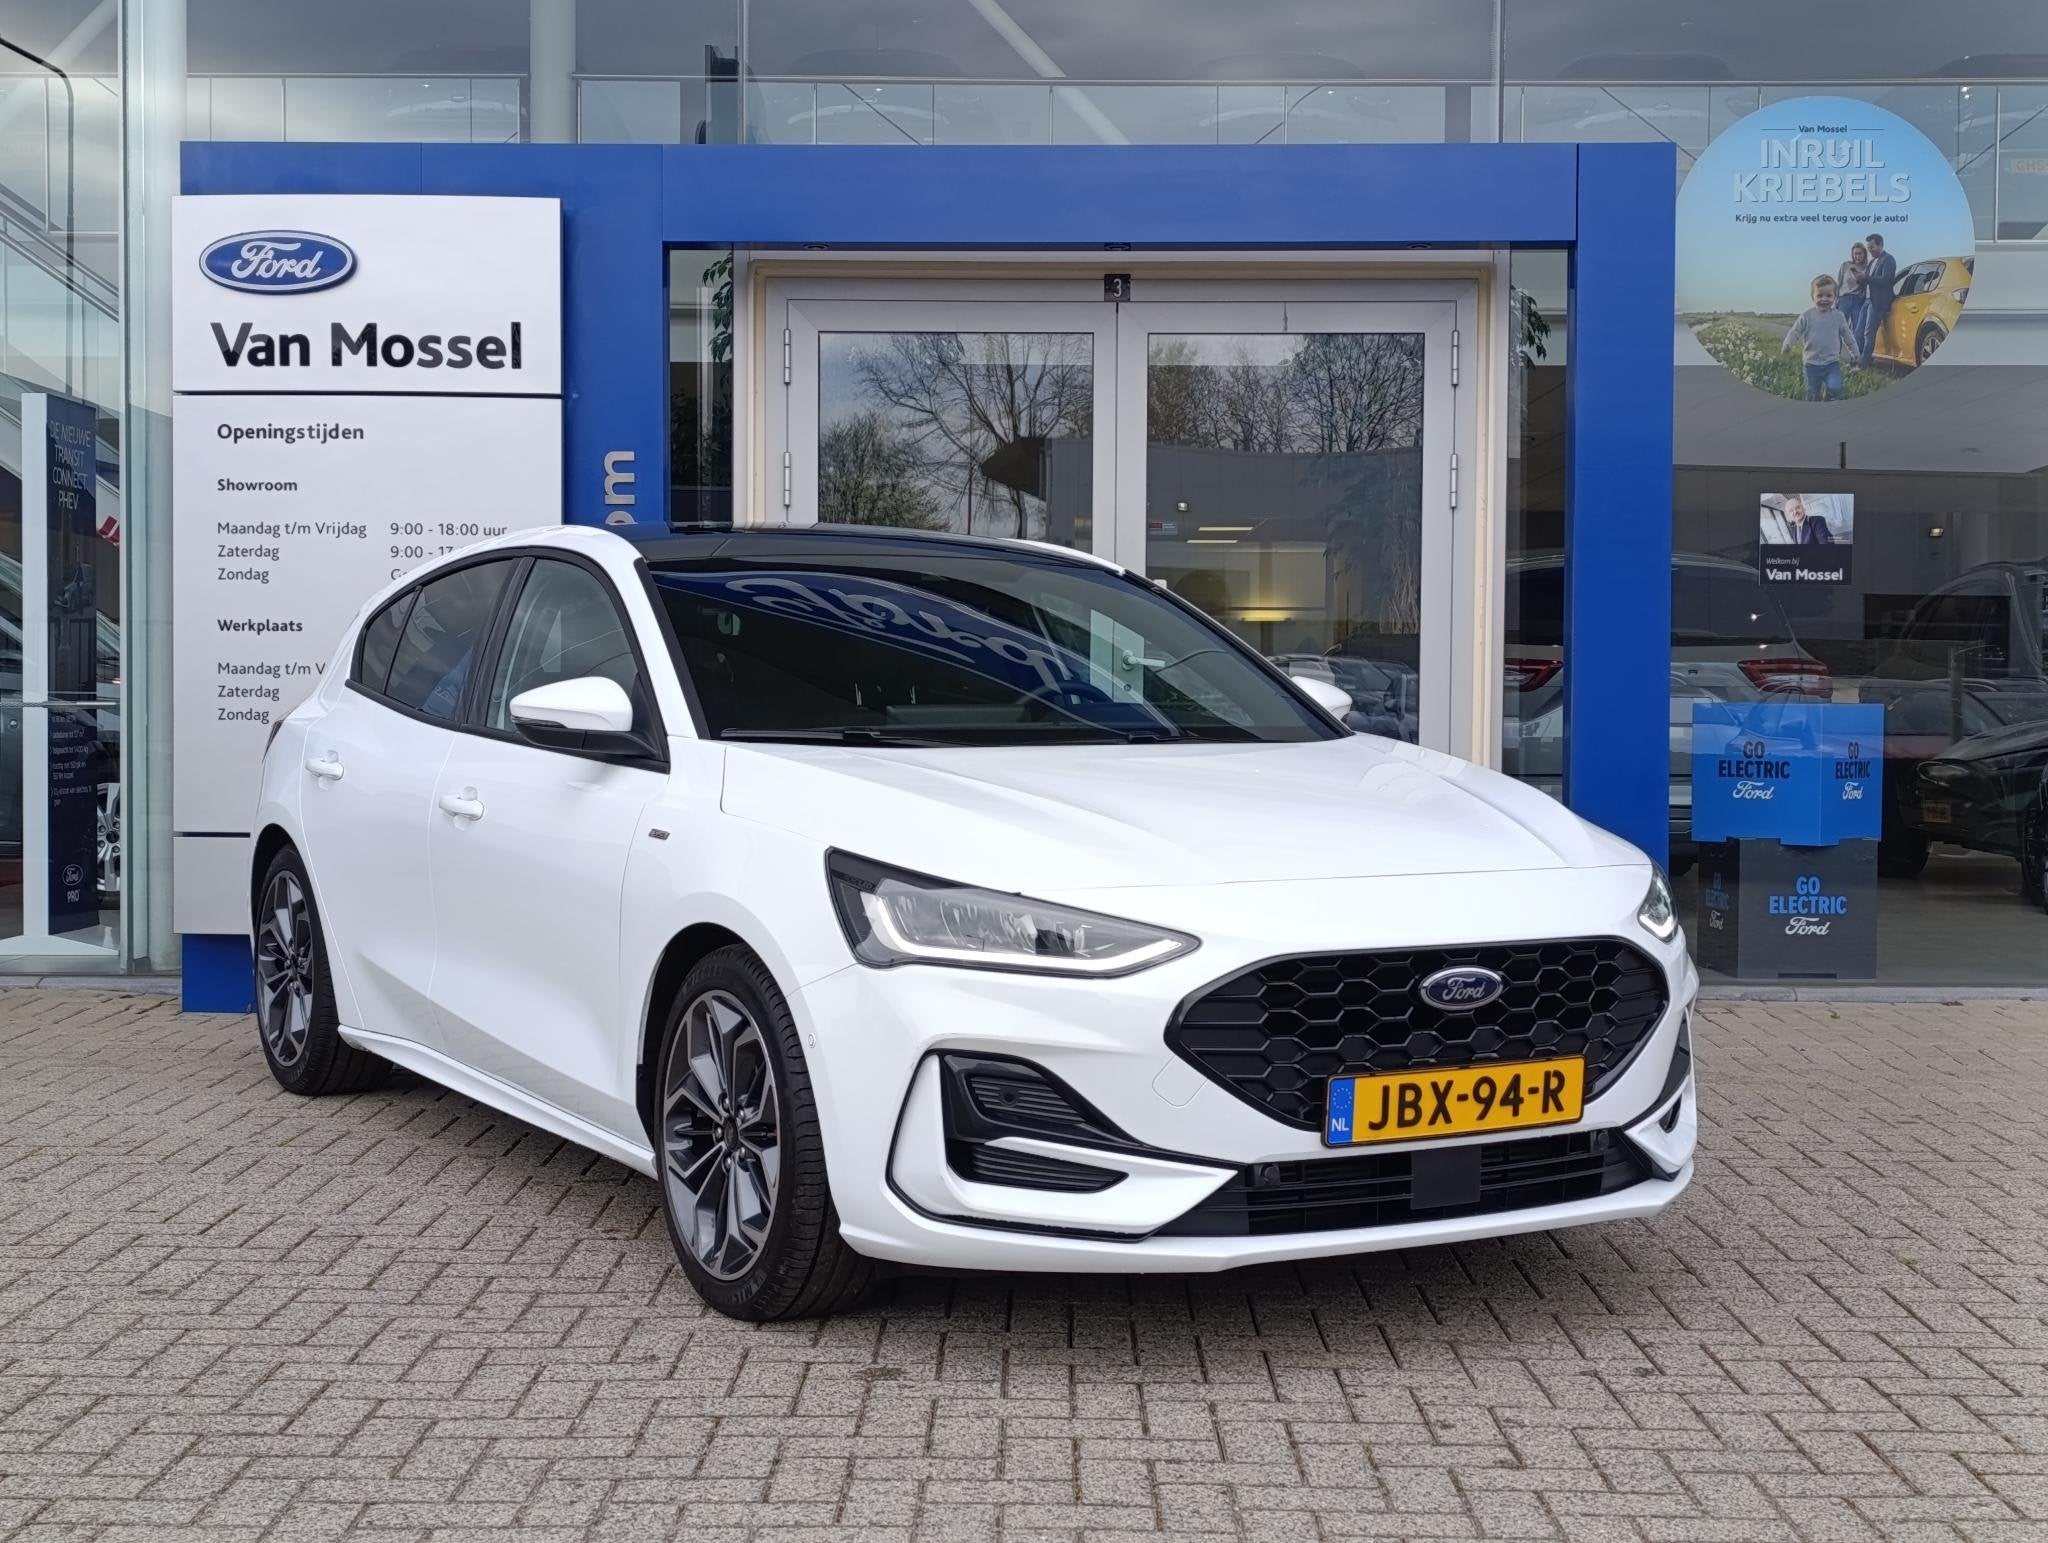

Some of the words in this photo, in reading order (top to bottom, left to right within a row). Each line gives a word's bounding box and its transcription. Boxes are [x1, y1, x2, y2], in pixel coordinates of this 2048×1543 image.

[1798, 124, 1815, 133] Van
[1817, 123, 1848, 133] Mossel
[1760, 137, 1886, 169] INRUIL
[1733, 172, 1912, 204] KRIEBELS
[1735, 213, 1758, 225] Krijg
[1774, 214, 1798, 223] extra
[1800, 213, 1820, 223] veel
[1823, 214, 1847, 224] terug
[1872, 213, 1882, 224] je
[1884, 213, 1909, 223] auto!
[230, 240, 324, 280] Ford
[1113, 278, 1122, 298] 3
[210, 322, 311, 368] Van
[331, 321, 522, 370] Mossel
[49, 420, 59, 440] DE
[60, 425, 92, 448] NIEUWE
[217, 422, 364, 445] Openingstijden
[54, 444, 85, 468] TRANSIT
[52, 466, 88, 490] CONNECT
[217, 478, 298, 492] Showroom
[58, 490, 79, 511] PHEV
[217, 522, 281, 539] Maandag
[285, 522, 311, 537] t/m
[315, 522, 367, 540] Vrijdag
[390, 522, 424, 536] 9:00
[437, 522, 480, 536] 18:00
[483, 525, 508, 536] uur
[217, 545, 280, 562] Zaterdag
[390, 545, 424, 558] 9:00
[217, 567, 270, 585] Zondag
[1766, 568, 1792, 580] Van
[1796, 567, 1843, 580] Mossel
[217, 618, 303, 636] Werkplaats
[217, 662, 281, 679] Maandag
[285, 662, 311, 677] t/m
[217, 685, 280, 702] Zaterdag
[217, 708, 270, 725] Zondag
[1743, 741, 1765, 759] GO
[1848, 741, 1860, 760] GO
[1718, 760, 1791, 779] ELECTRIC
[1835, 760, 1871, 779] ELECTRIC
[1732, 780, 1775, 800] Ford
[1842, 781, 1863, 800] Ford
[1796, 876, 1820, 895] GO
[67, 889, 80, 904] PRO
[1769, 896, 1848, 915] ELECTRIC
[1785, 916, 1830, 936] Ford
[1442, 976, 1486, 1000] Ford
[1331, 1117, 1350, 1132] NL
[1368, 1069, 1566, 1131] JBX-94-R
